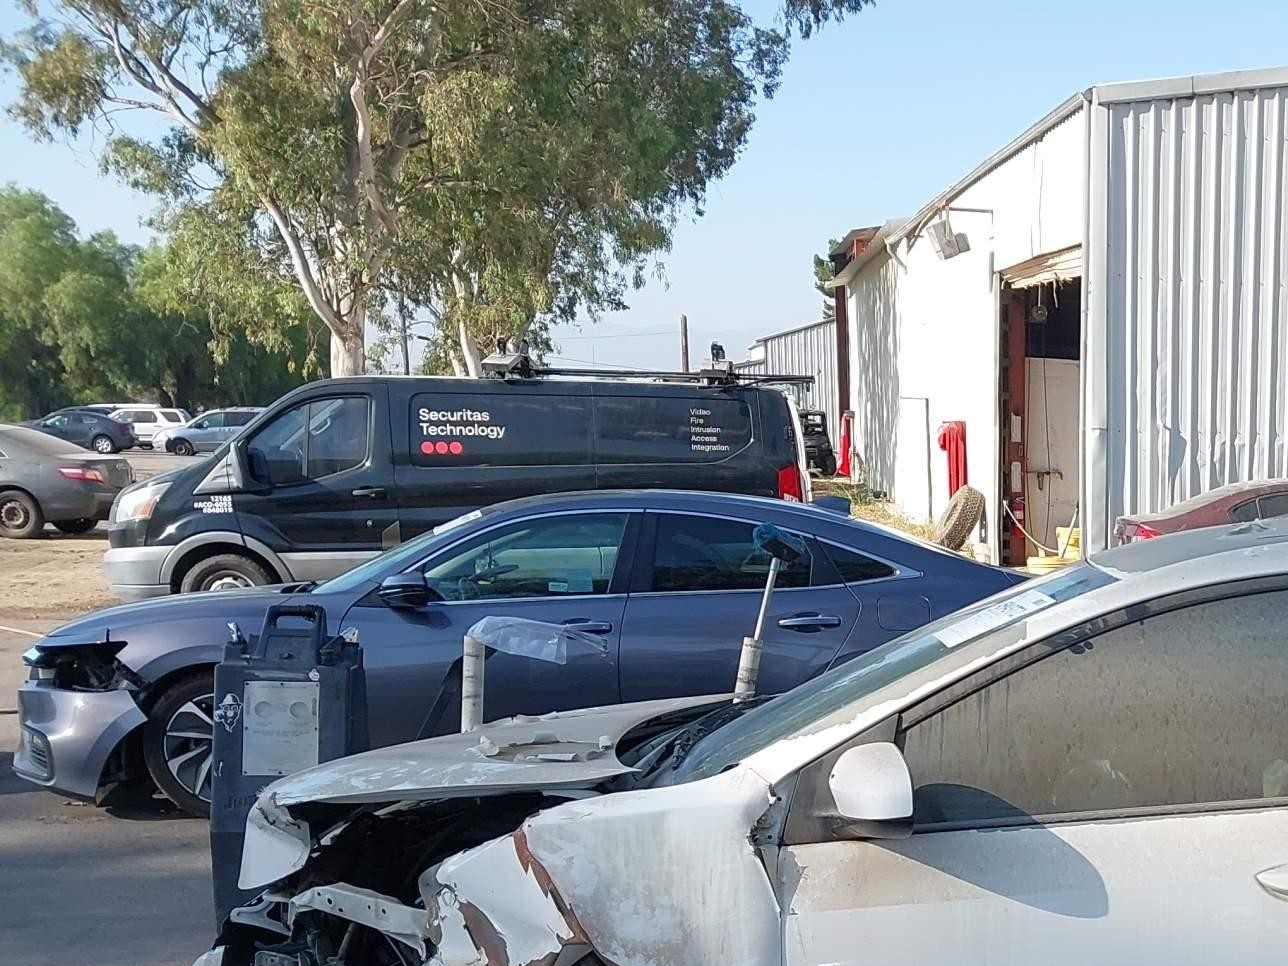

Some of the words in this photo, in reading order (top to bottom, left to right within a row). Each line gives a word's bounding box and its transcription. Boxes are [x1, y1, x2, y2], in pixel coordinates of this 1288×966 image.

[418, 408, 490, 421] Securitas
[690, 408, 711, 416] Video
[419, 422, 506, 439] Technology
[691, 443, 730, 452] Integration
